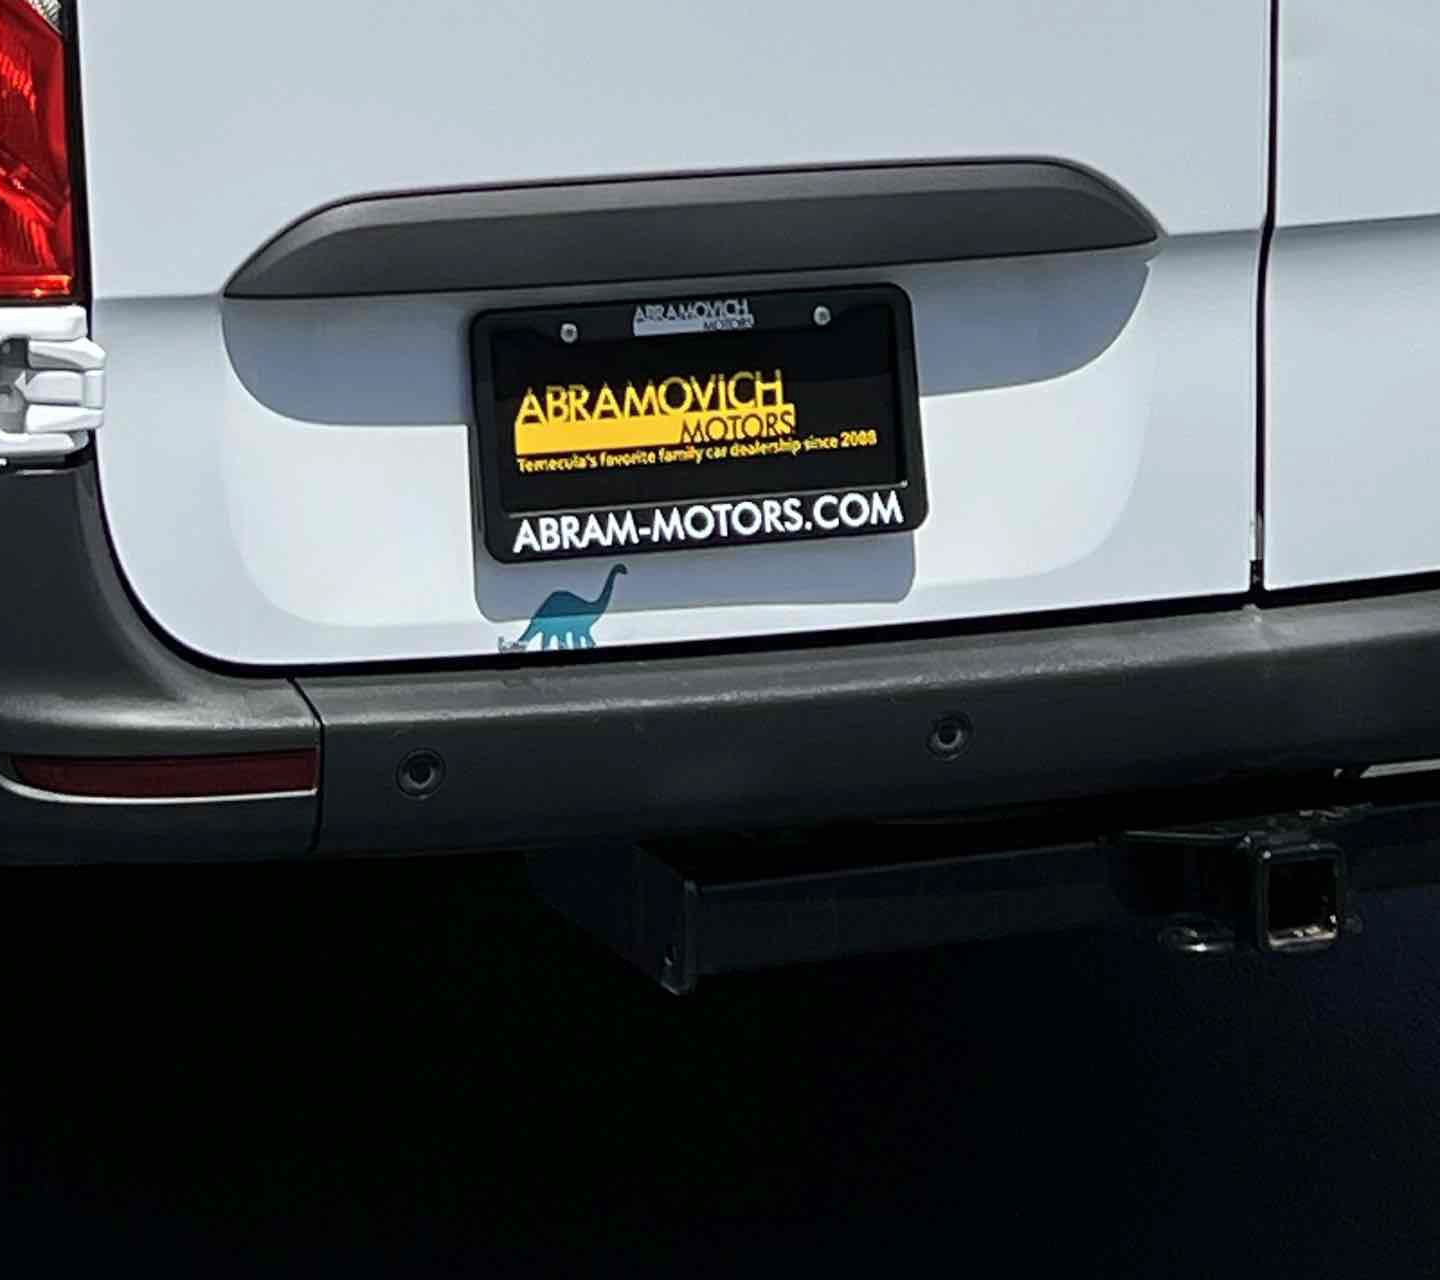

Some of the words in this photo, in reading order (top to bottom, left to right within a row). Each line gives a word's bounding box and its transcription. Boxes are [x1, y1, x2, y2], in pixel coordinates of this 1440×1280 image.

[634, 299, 749, 322] ABRAMOVICH
[516, 369, 783, 424] ABRAMOVICH
[681, 412, 795, 443] MOTORS
[517, 453, 598, 472] Temecula's
[600, 451, 656, 467] favorite
[658, 446, 703, 465] family
[705, 445, 728, 460] car
[729, 439, 802, 457] dealership
[803, 435, 839, 450] since
[512, 490, 904, 553] ABRAM-MOTORS.COM
